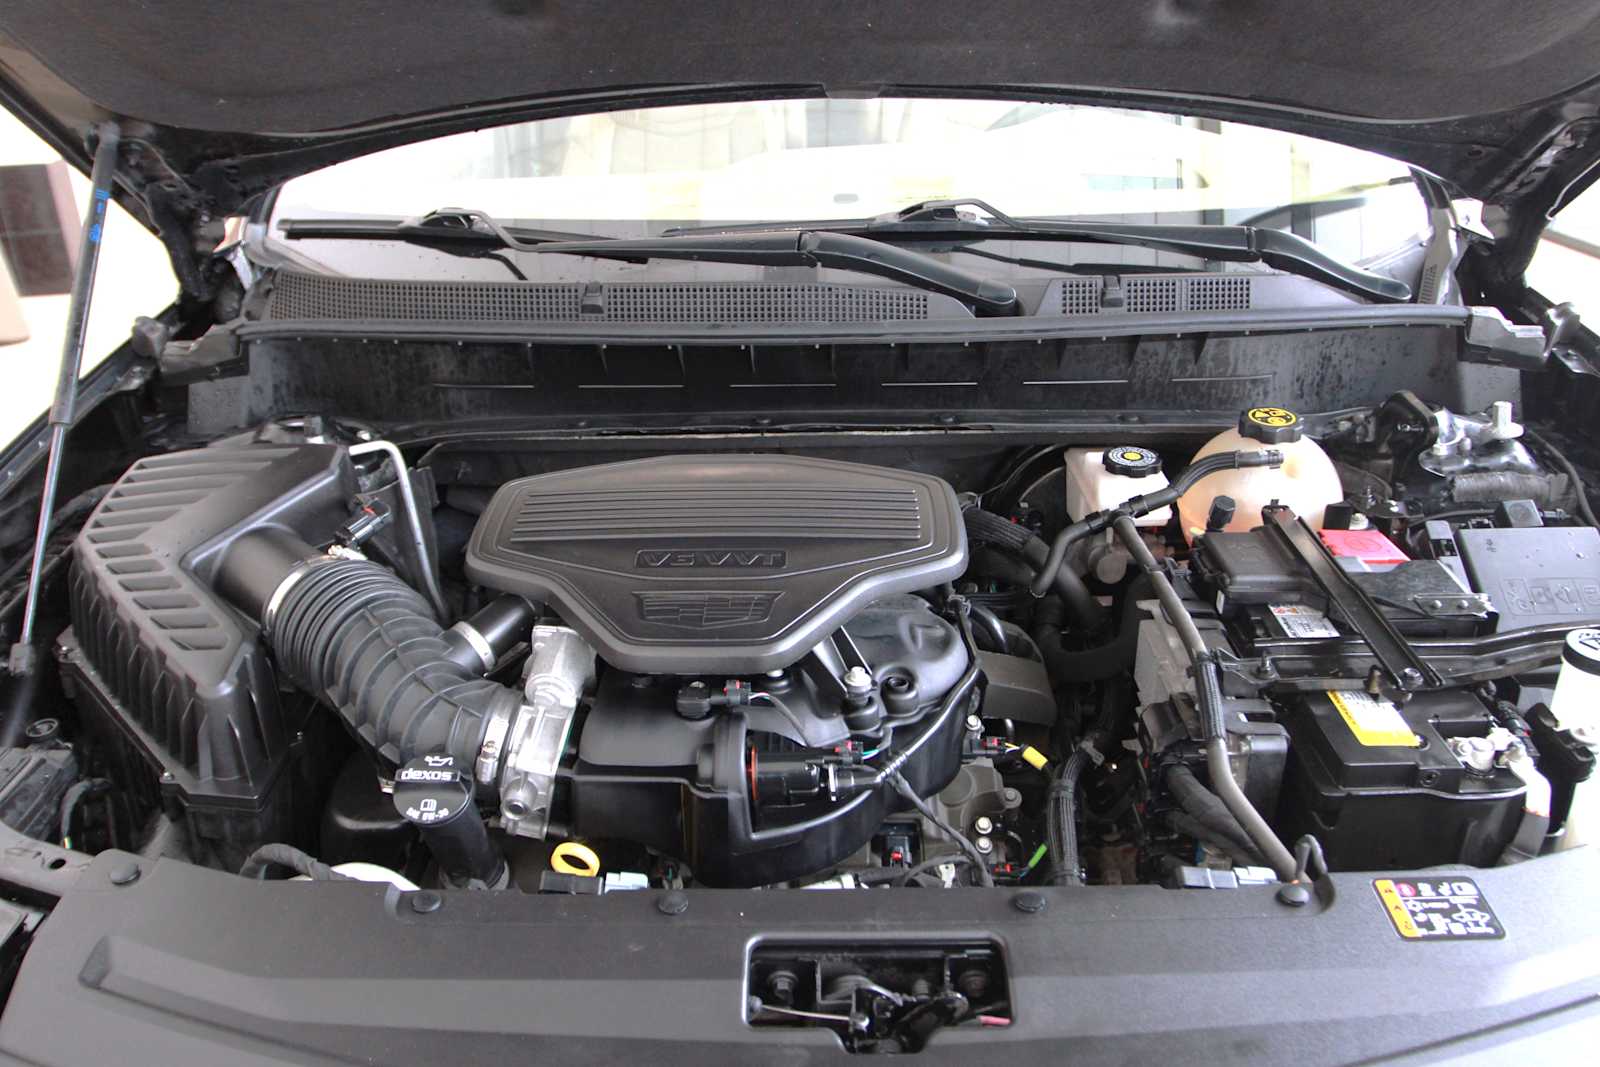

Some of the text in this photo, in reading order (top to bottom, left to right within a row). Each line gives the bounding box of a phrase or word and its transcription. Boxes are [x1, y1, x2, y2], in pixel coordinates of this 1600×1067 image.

[640, 551, 783, 567] V6 VVT
[400, 767, 453, 781] dexos
